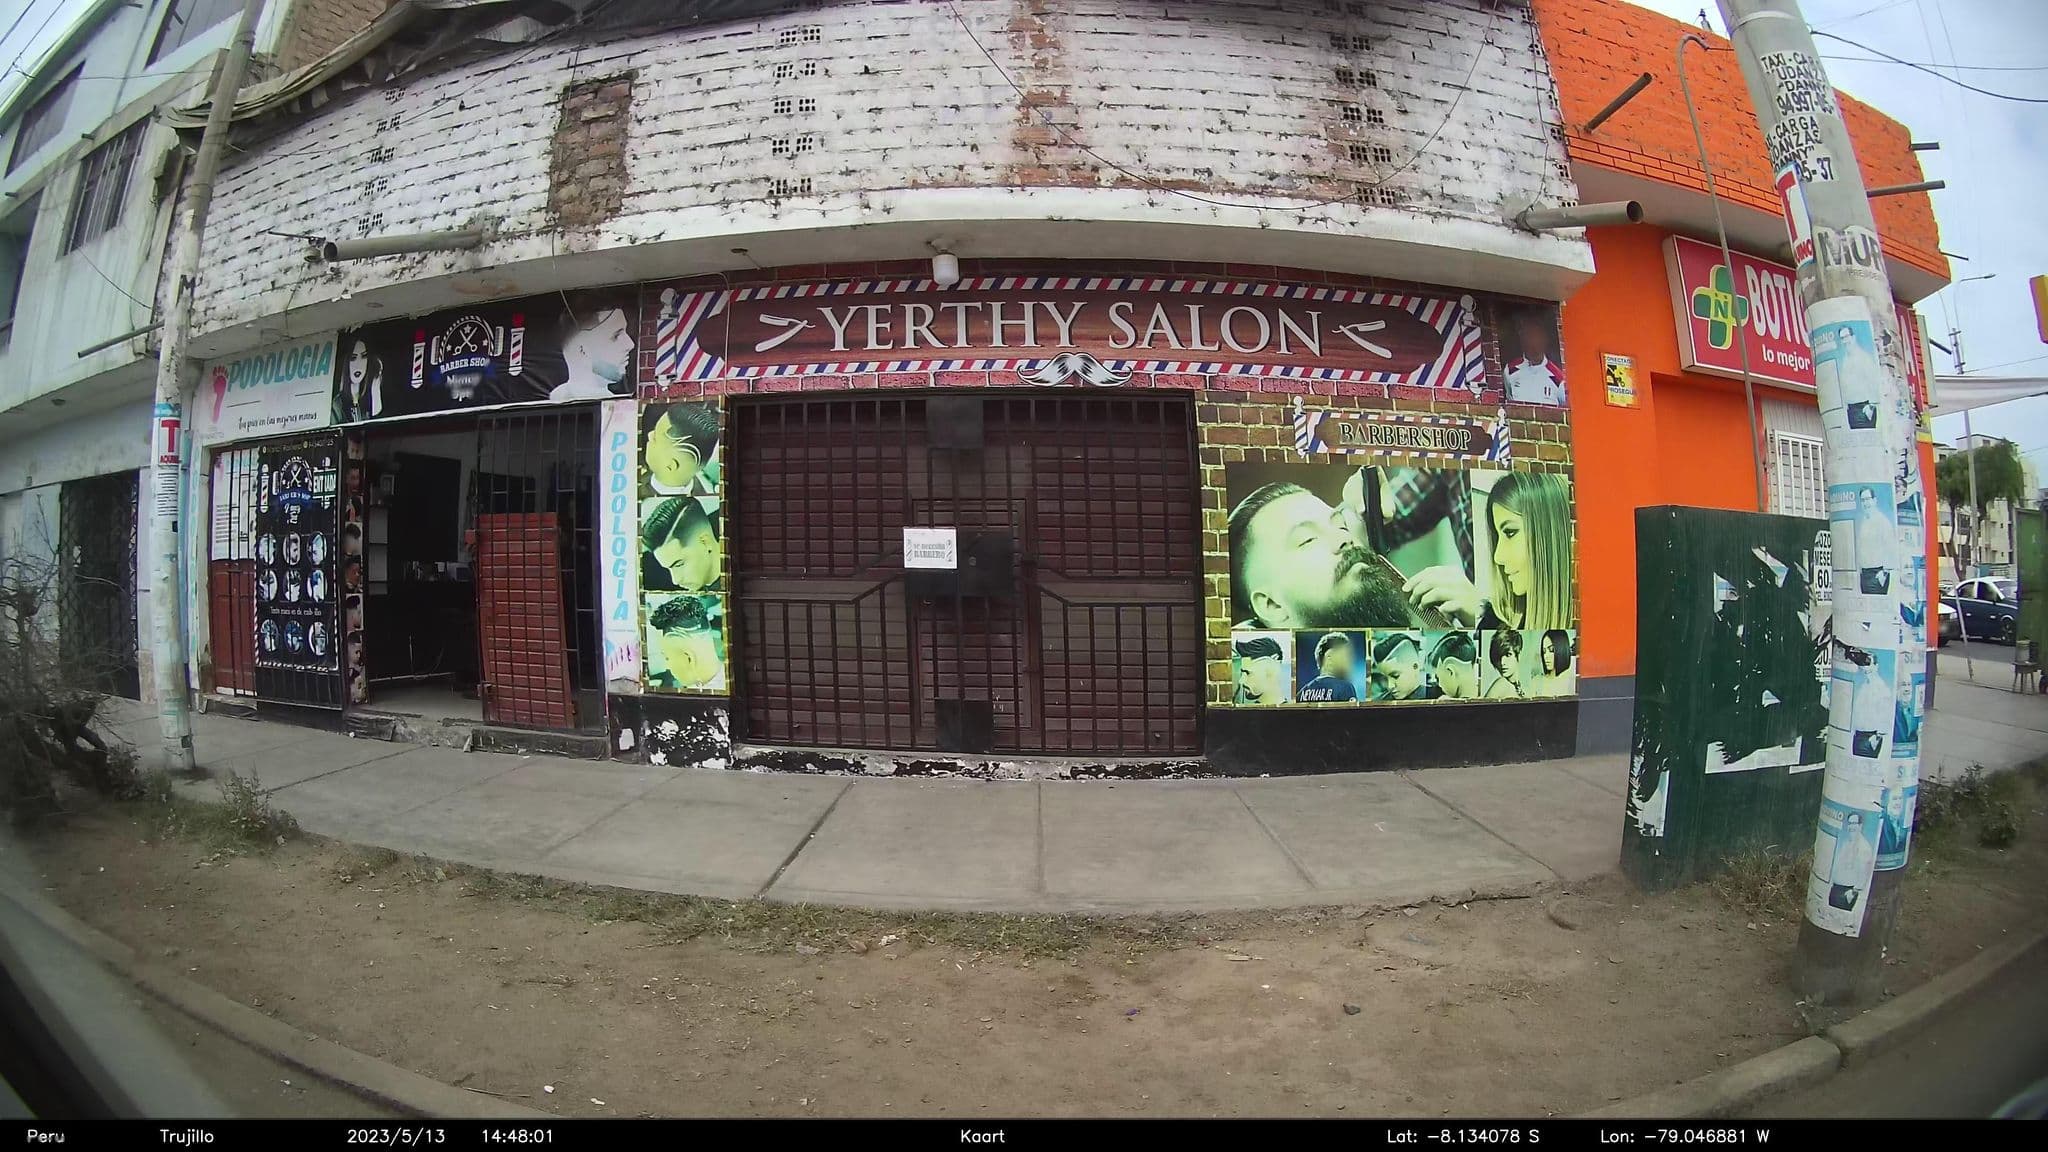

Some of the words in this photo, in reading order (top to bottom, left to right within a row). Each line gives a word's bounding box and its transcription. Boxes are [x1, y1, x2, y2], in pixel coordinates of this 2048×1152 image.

[817, 301, 1088, 351] YERTHY
[1108, 302, 1323, 357] SALON
[228, 341, 333, 392] PODOLOGIA
[440, 359, 469, 375] BARBER
[1762, 344, 1774, 363] lo
[1777, 351, 1810, 372] mejor
[161, 419, 180, 453] T
[1338, 422, 1472, 451] BARBERSHOP
[611, 431, 629, 620] PODOLOGIA
